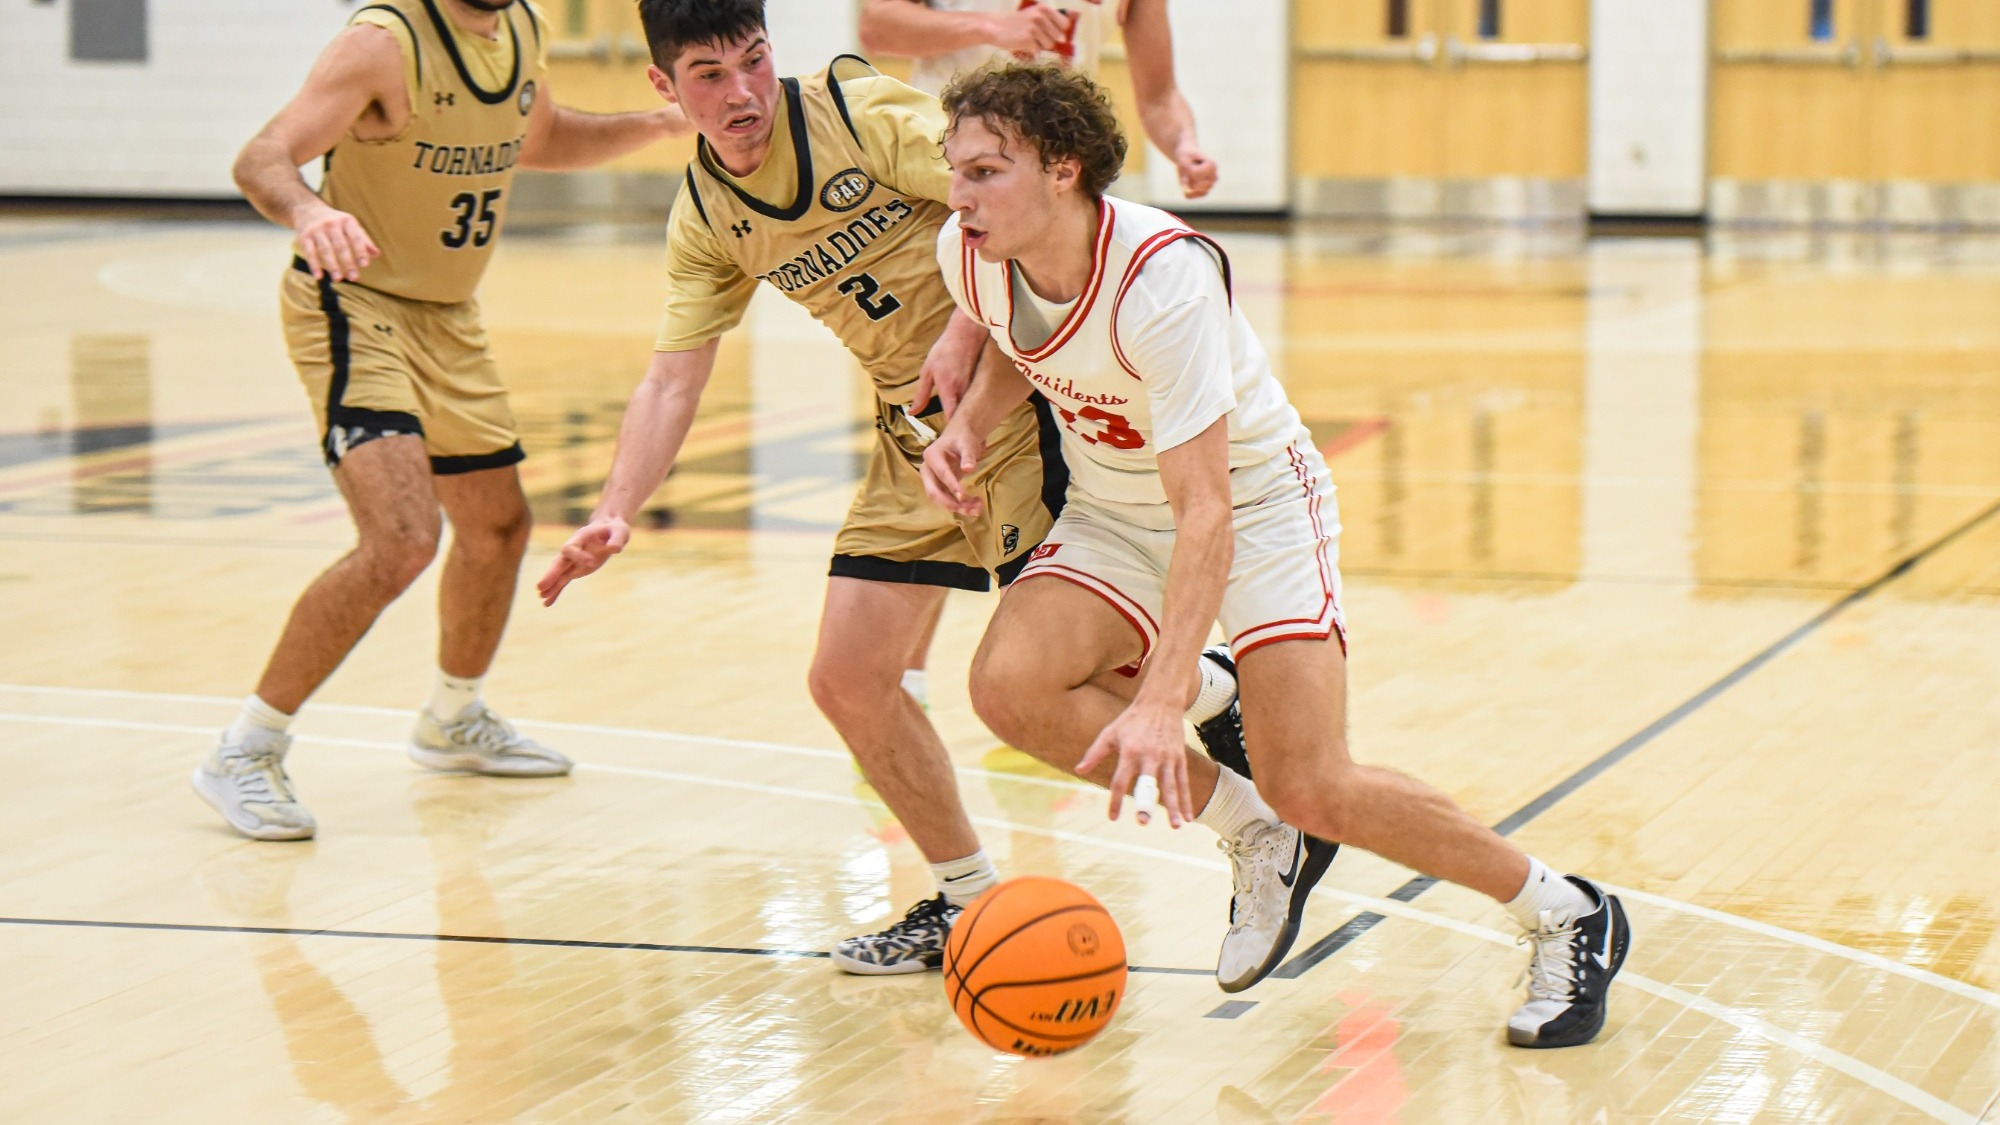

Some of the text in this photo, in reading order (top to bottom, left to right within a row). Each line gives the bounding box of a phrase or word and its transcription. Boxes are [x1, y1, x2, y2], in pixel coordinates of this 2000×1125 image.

[830, 176, 864, 205] PAC
[440, 188, 502, 250] 35
[836, 272, 902, 322] 2
